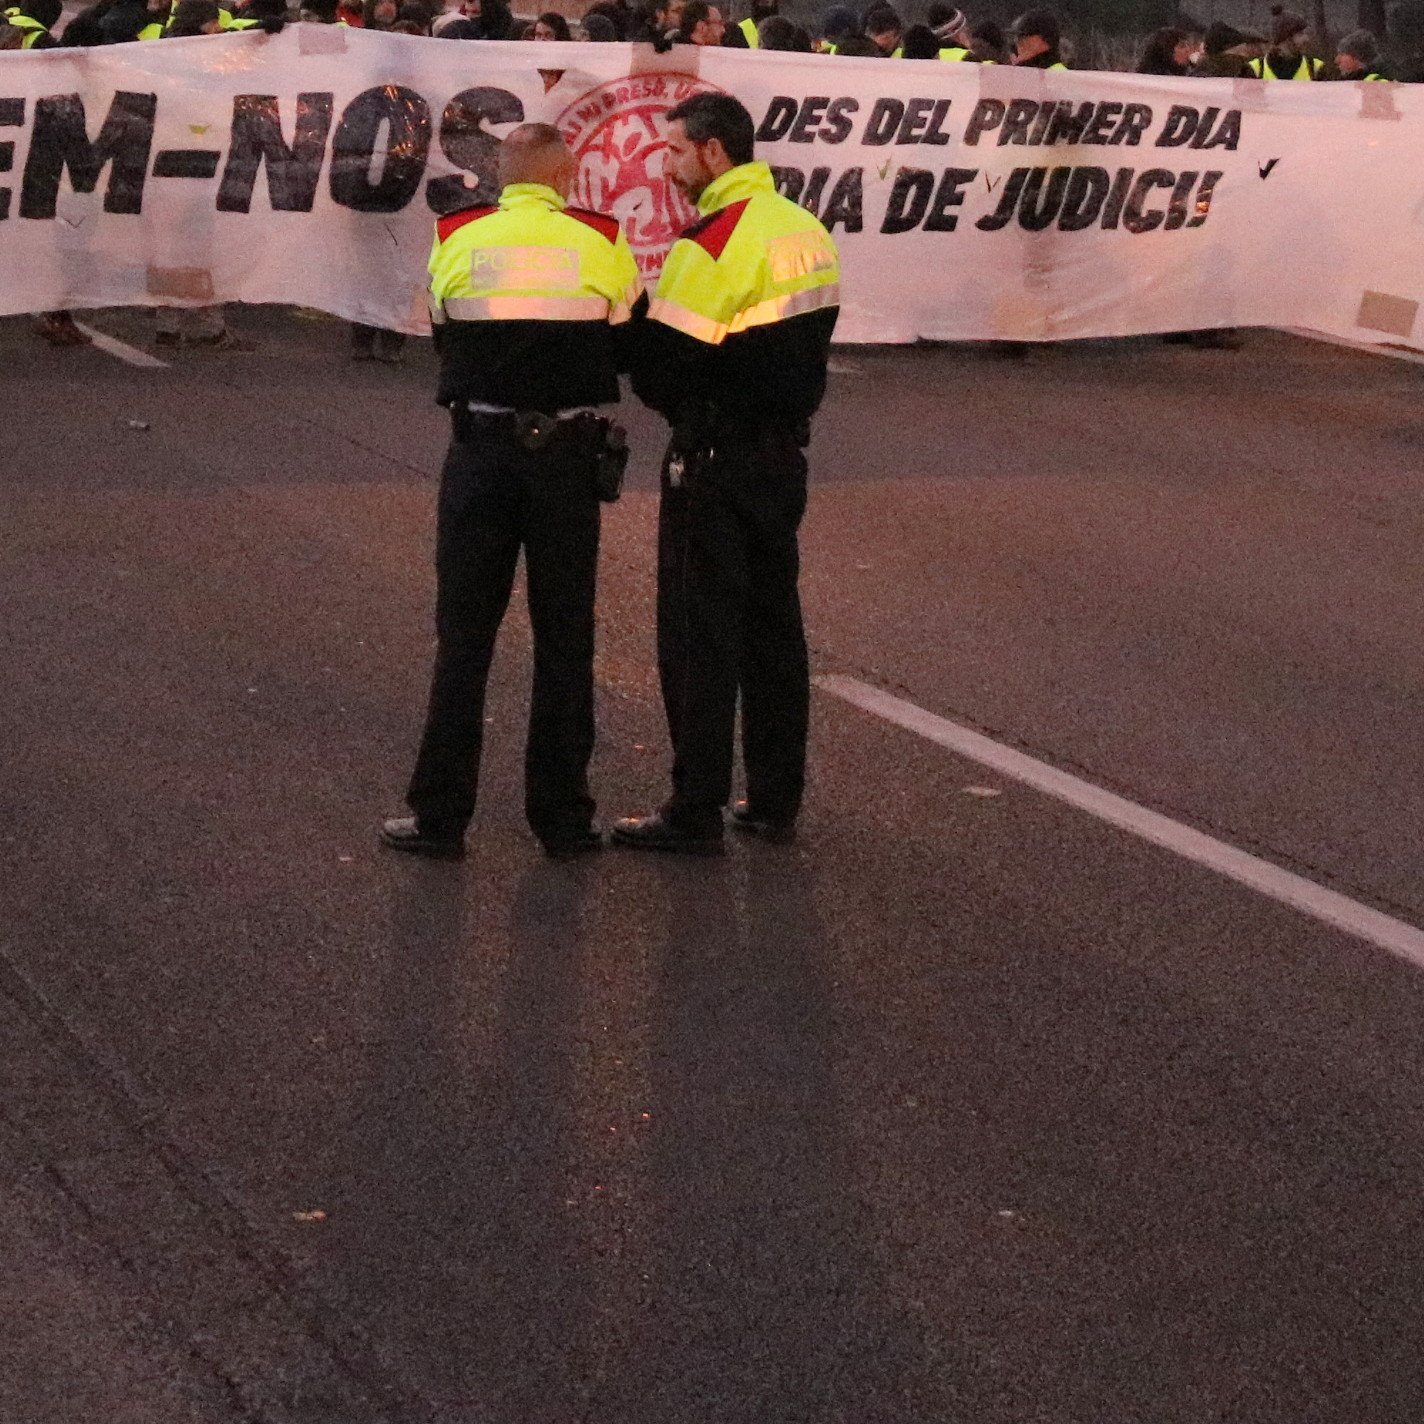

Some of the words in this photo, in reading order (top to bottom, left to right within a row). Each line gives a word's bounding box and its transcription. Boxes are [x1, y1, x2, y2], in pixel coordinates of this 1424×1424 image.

[755, 96, 860, 145] DES
[861, 98, 952, 146] DEL
[963, 98, 1153, 146] PRIMER
[1155, 104, 1242, 151] DIA
[769, 164, 864, 234] DIA
[879, 166, 980, 234] DE
[975, 166, 1224, 234] JUDICI!
